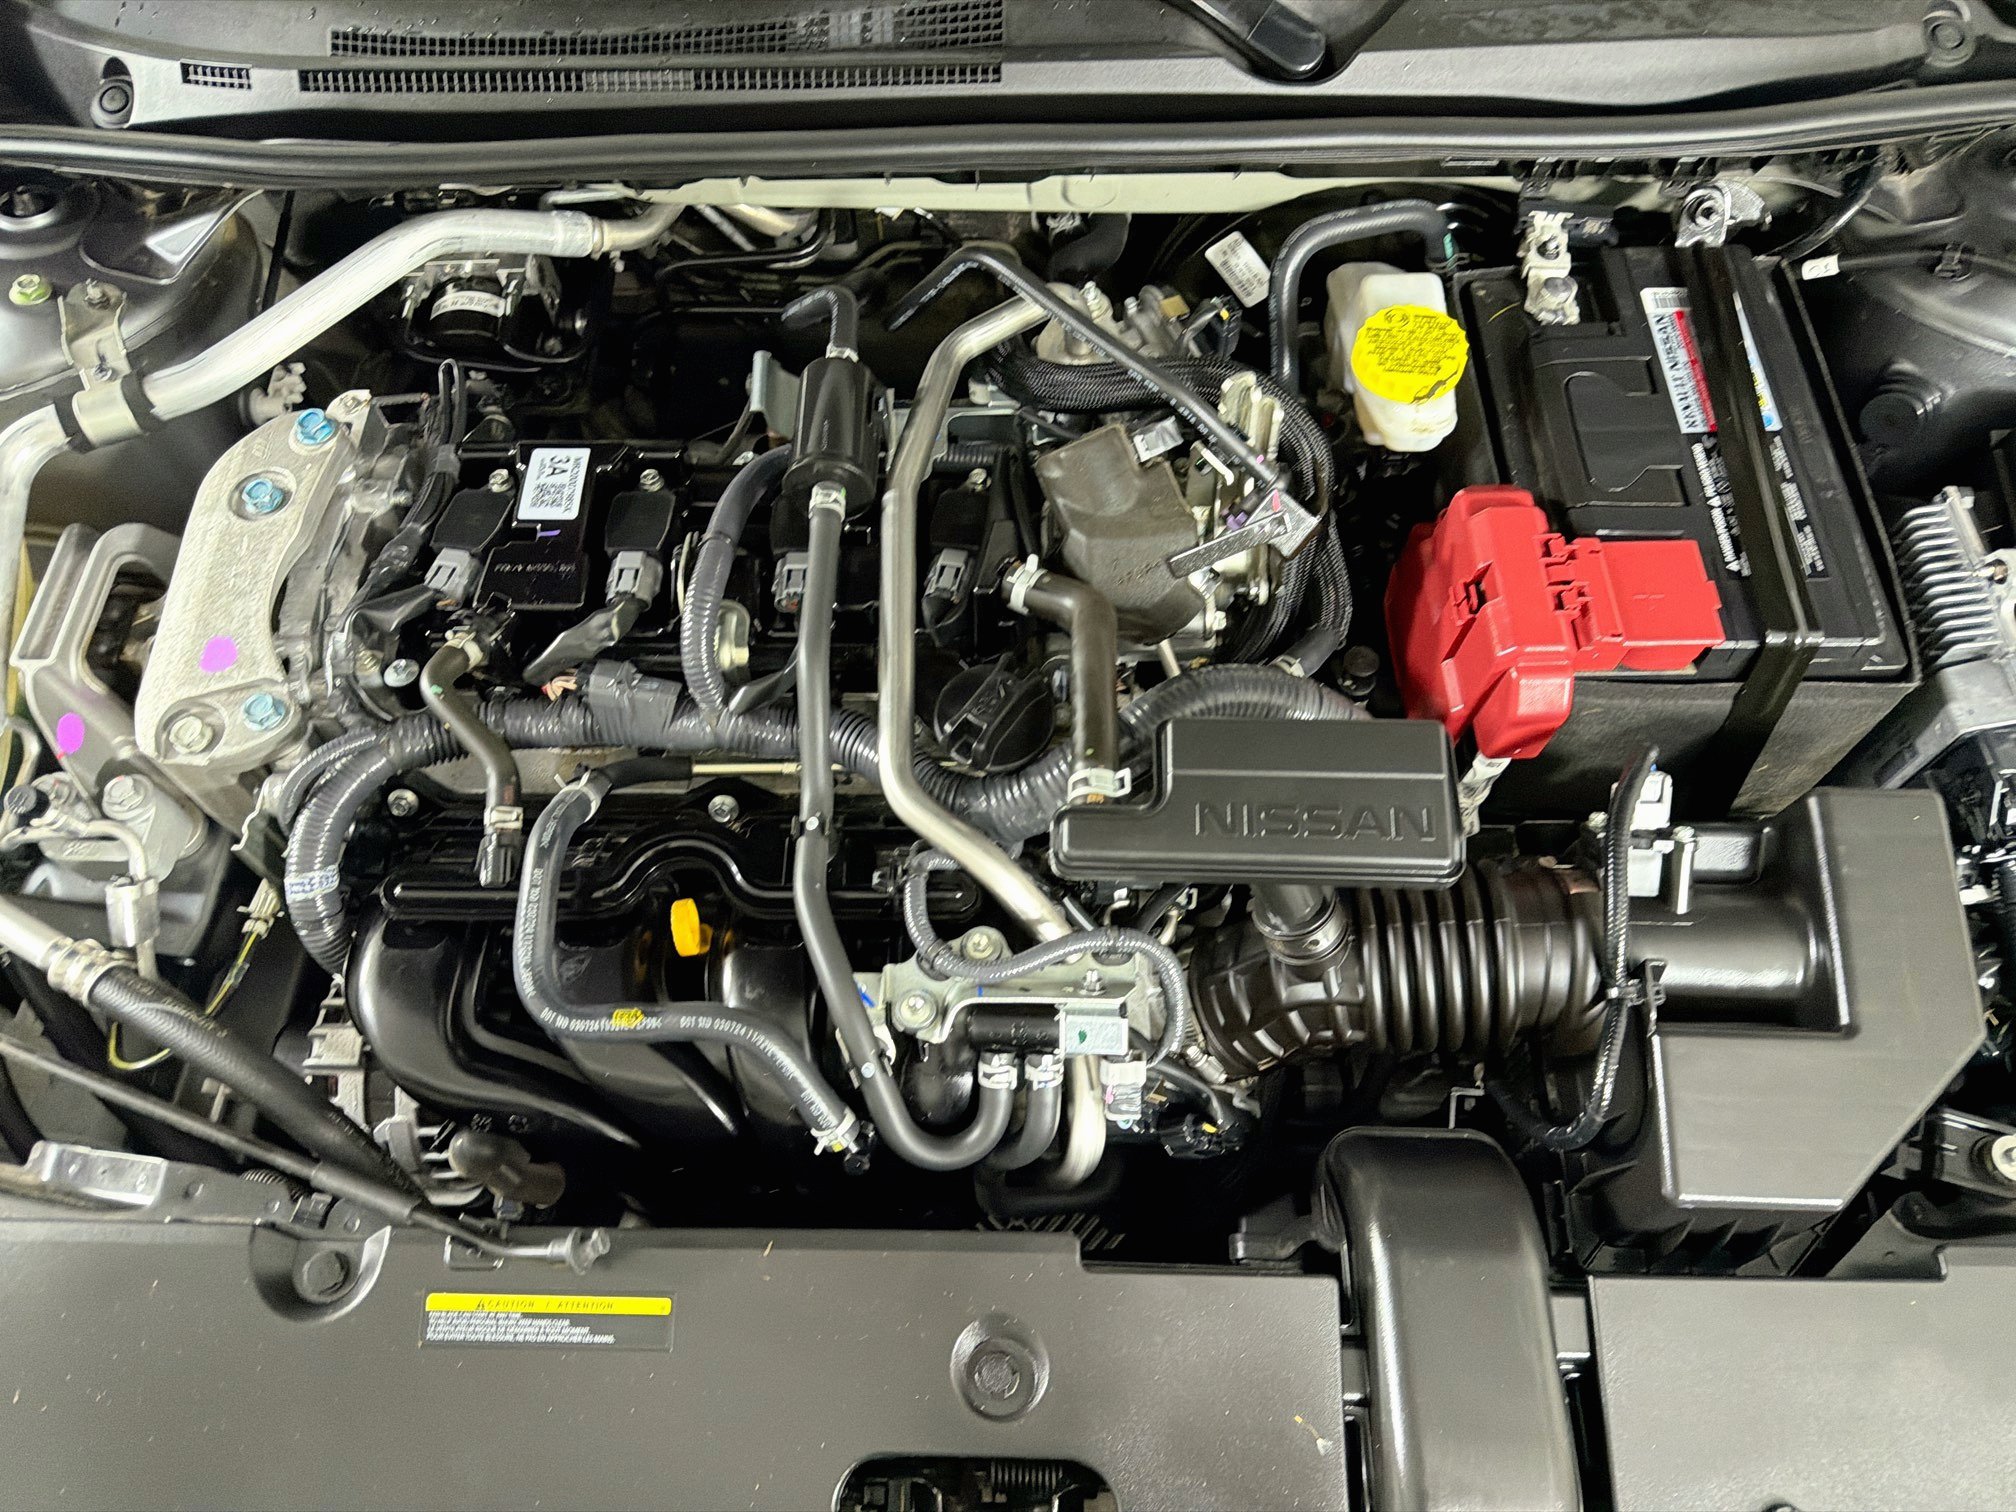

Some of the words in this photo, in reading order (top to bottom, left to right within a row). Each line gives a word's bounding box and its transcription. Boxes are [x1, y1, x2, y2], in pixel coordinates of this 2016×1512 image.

[1653, 314, 1681, 371] NISSAN
[546, 456, 571, 478] 3A
[1195, 802, 1436, 841] NISSAN
[487, 1300, 535, 1309] CAUTION
[557, 1301, 615, 1310] ATTENTION
